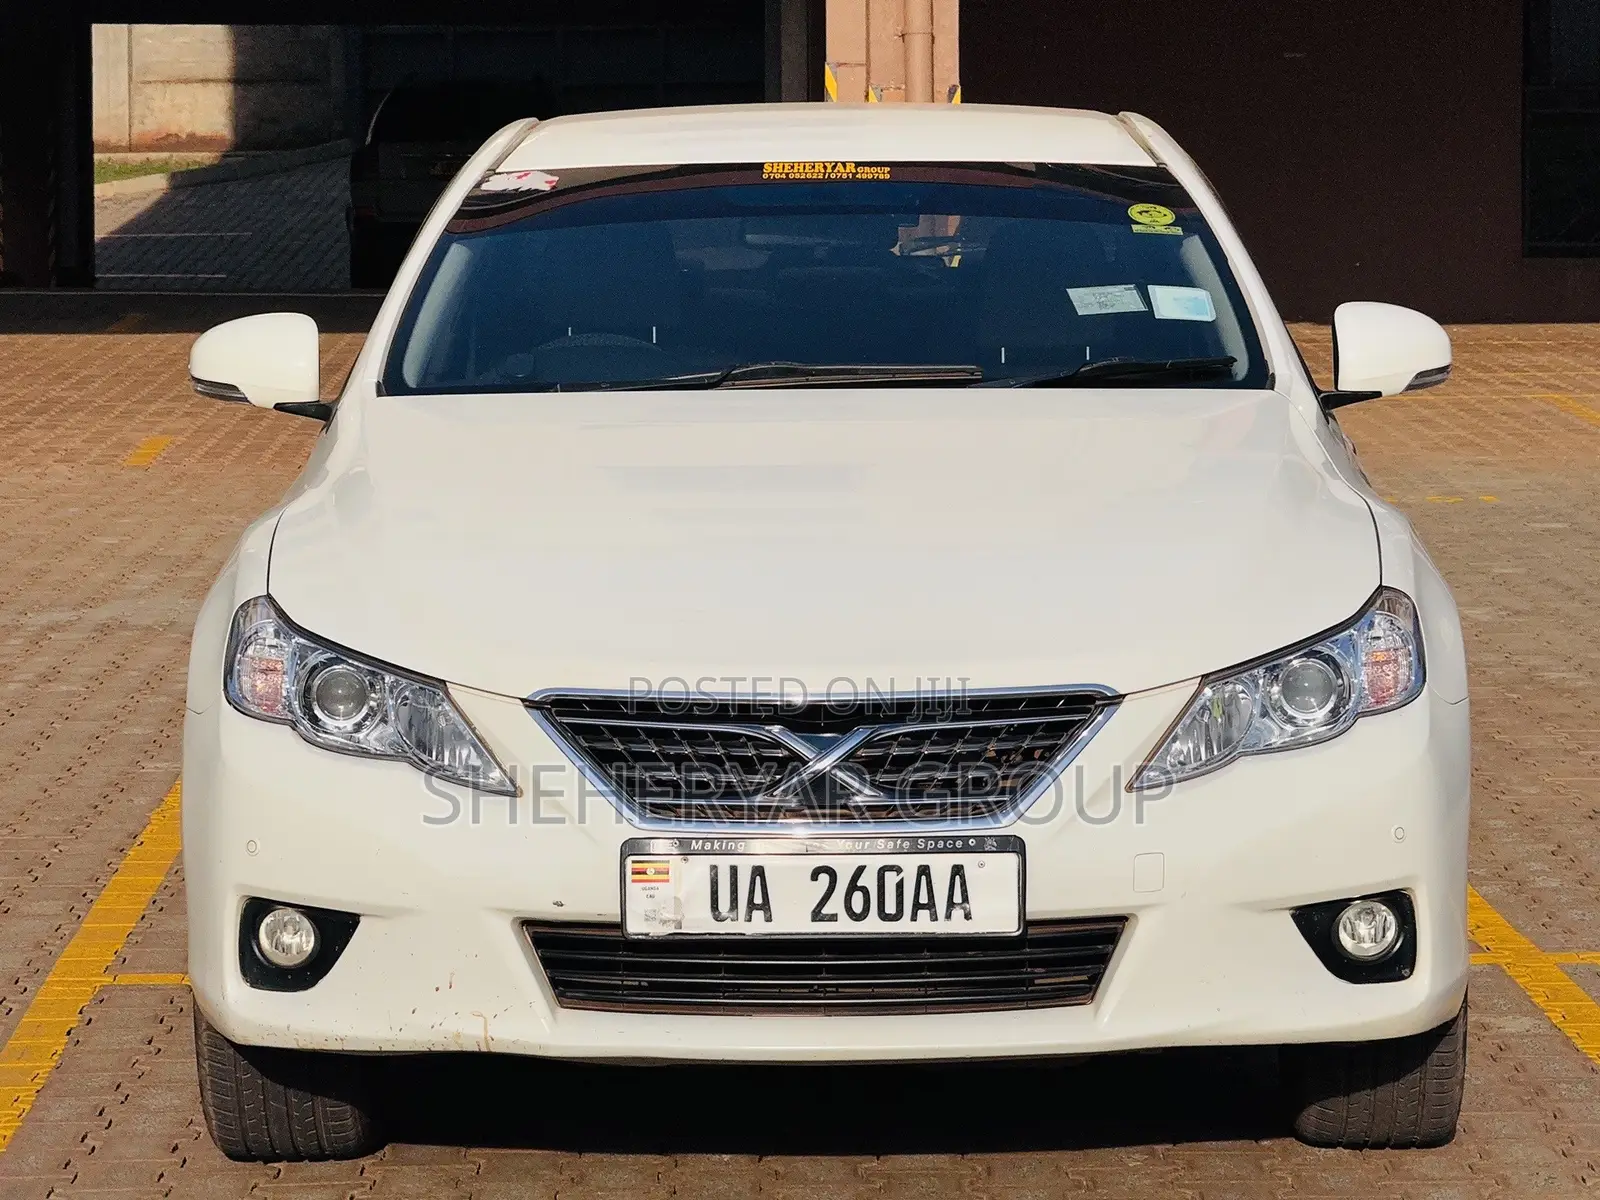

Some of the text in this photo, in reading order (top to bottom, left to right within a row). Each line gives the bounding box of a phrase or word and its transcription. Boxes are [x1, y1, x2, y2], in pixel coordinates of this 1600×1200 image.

[763, 162, 856, 173] SHEHERYAR
[762, 172, 787, 180] 0704
[690, 840, 748, 852] Making
[836, 839, 871, 850] Your
[876, 838, 910, 850] Safe
[917, 838, 964, 850] Space
[710, 864, 973, 923] UA 260AA
